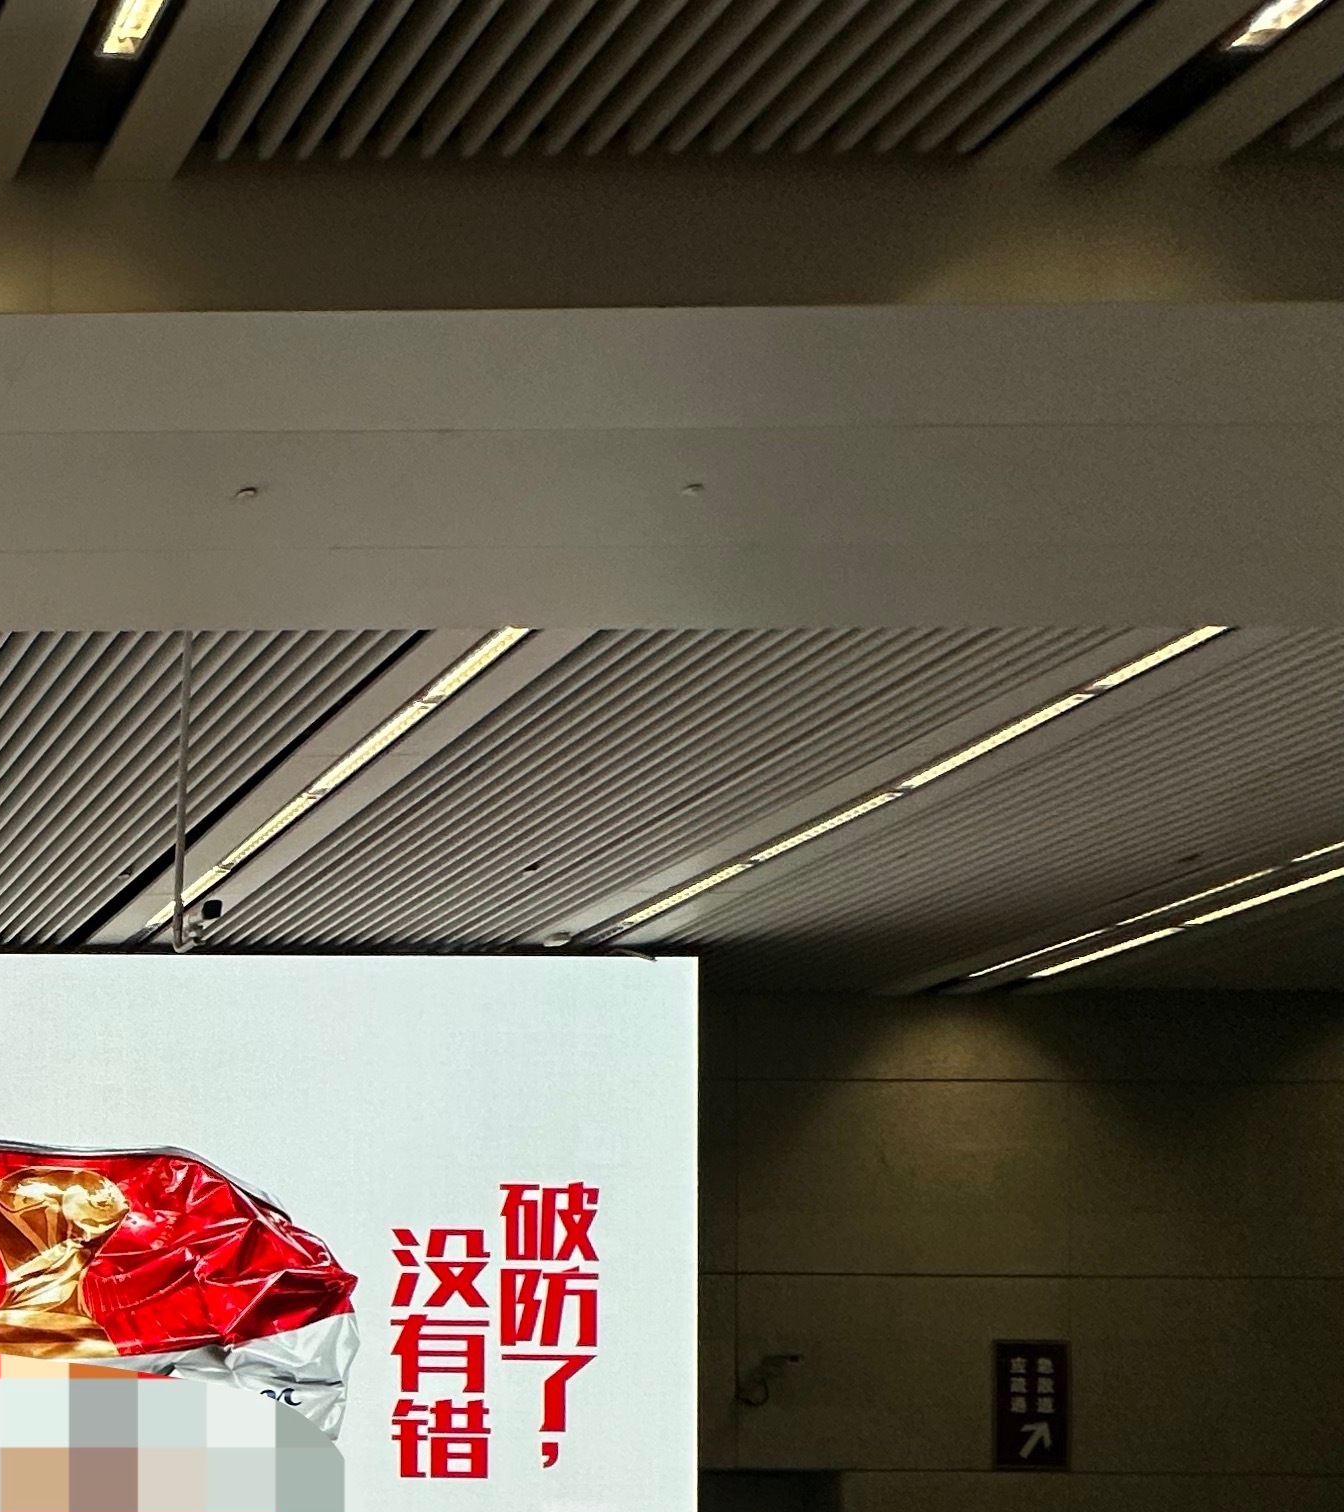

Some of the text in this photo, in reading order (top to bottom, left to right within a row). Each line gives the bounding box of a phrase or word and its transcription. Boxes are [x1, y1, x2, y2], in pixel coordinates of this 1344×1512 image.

[390, 1228, 491, 1478] 没有错
[499, 1181, 600, 1468] 破防了，
